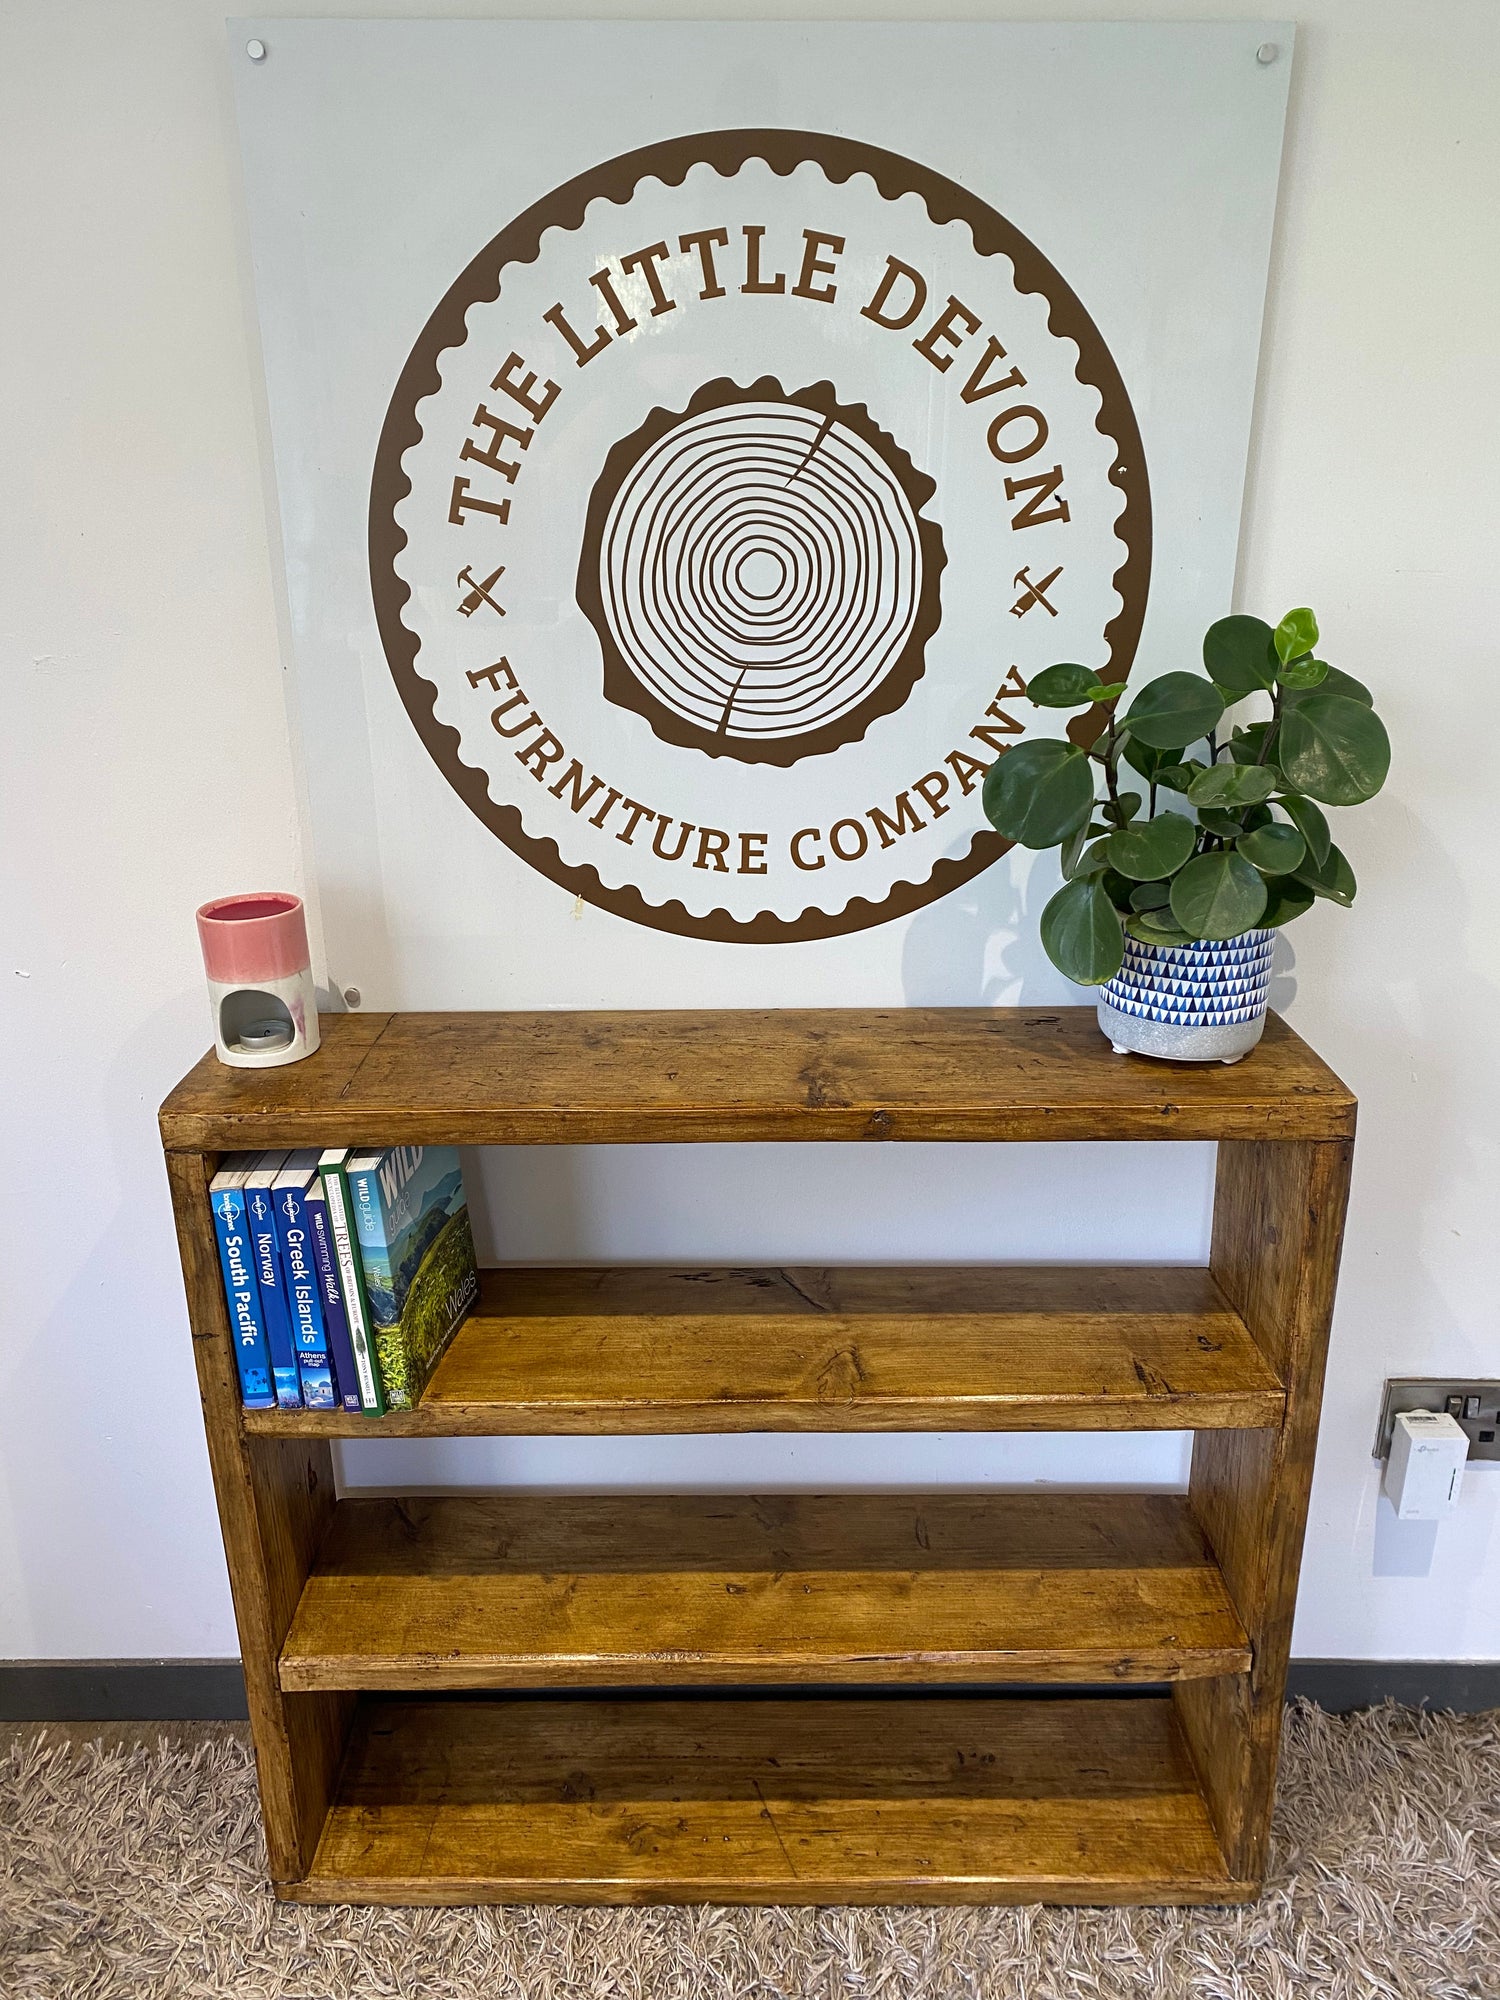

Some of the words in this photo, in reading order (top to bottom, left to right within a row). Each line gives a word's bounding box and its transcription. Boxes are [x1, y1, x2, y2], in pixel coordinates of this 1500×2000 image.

[449, 352, 562, 526] THE
[543, 226, 846, 368] LITTLE
[861, 255, 1071, 532] DEVON
[466, 656, 768, 874] FURNITURE
[790, 665, 1039, 871] COMPANY
[379, 1146, 423, 1209] WILD
[226, 1236, 249, 1287] South
[257, 1233, 276, 1287] Norway
[287, 1229, 310, 1280] Greek
[334, 1222, 353, 1267] TREES
[324, 1274, 340, 1305] Walks
[373, 1265, 382, 1288] Wales
[445, 1270, 476, 1320] Wales
[234, 1291, 258, 1346] Pacific
[295, 1285, 318, 1344] Islands
